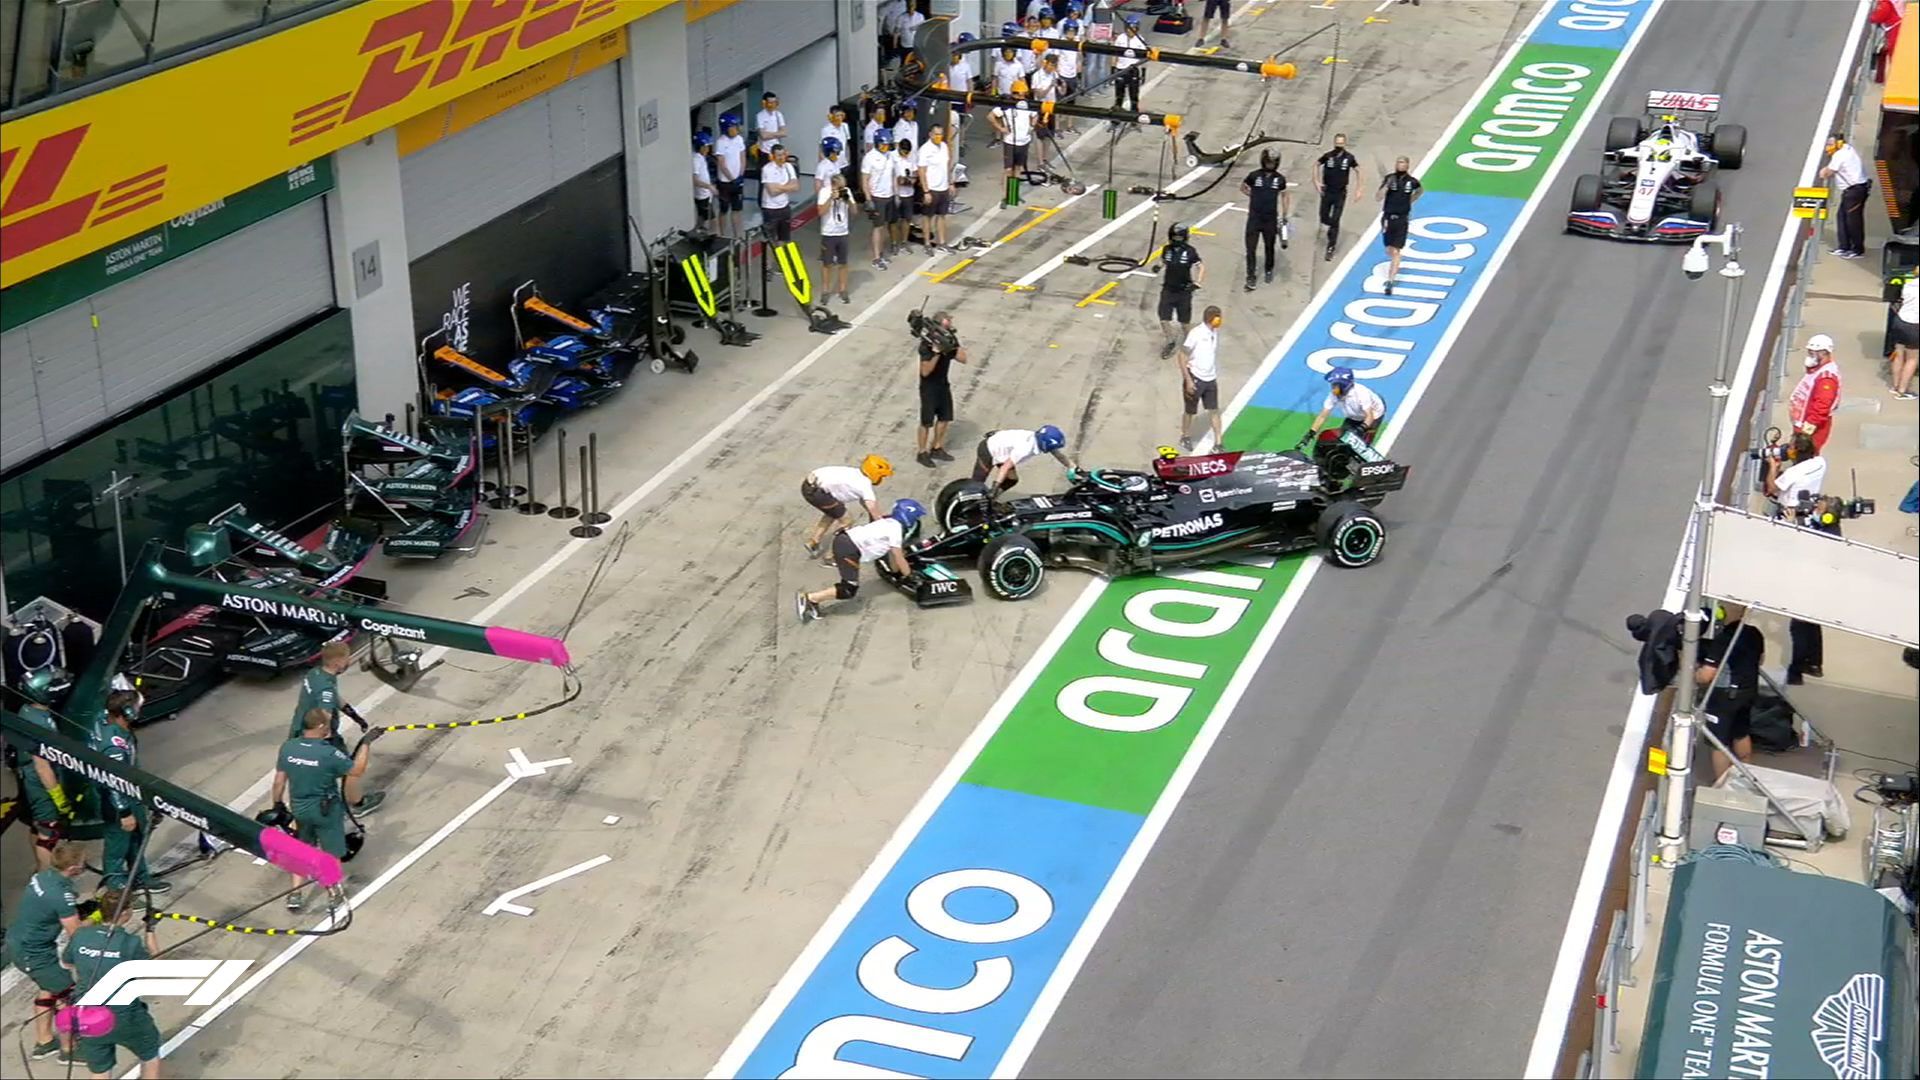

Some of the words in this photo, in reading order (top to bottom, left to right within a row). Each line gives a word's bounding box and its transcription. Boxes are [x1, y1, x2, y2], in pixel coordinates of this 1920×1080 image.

[1456, 62, 1592, 172] aramco
[1638, 188, 1655, 196] 47
[105, 246, 131, 266] ASTON
[132, 233, 163, 255] MARTIN
[360, 255, 377, 279] 14
[452, 282, 471, 307] WE
[1306, 216, 1488, 380] aramco
[443, 301, 470, 330] RACE
[454, 321, 469, 345] AS
[1189, 459, 1227, 476] INEOS
[1361, 464, 1394, 476] EPSON
[410, 483, 437, 491] MARTIN
[1152, 513, 1224, 538] PETRONAS
[390, 539, 413, 547] ASTON
[414, 539, 440, 547] MARTIN
[930, 582, 957, 595] IWC
[222, 593, 278, 616] ASTON
[361, 618, 427, 640] Cognizant
[1055, 556, 1279, 732] ara
[39, 743, 86, 775] ASTON
[86, 764, 142, 800] MARTIN
[153, 796, 210, 830] Cognizant
[1695, 922, 1731, 996] FORMULA
[1738, 928, 1784, 1008] ASTON
[1681, 1049, 1712, 1079] TEA
